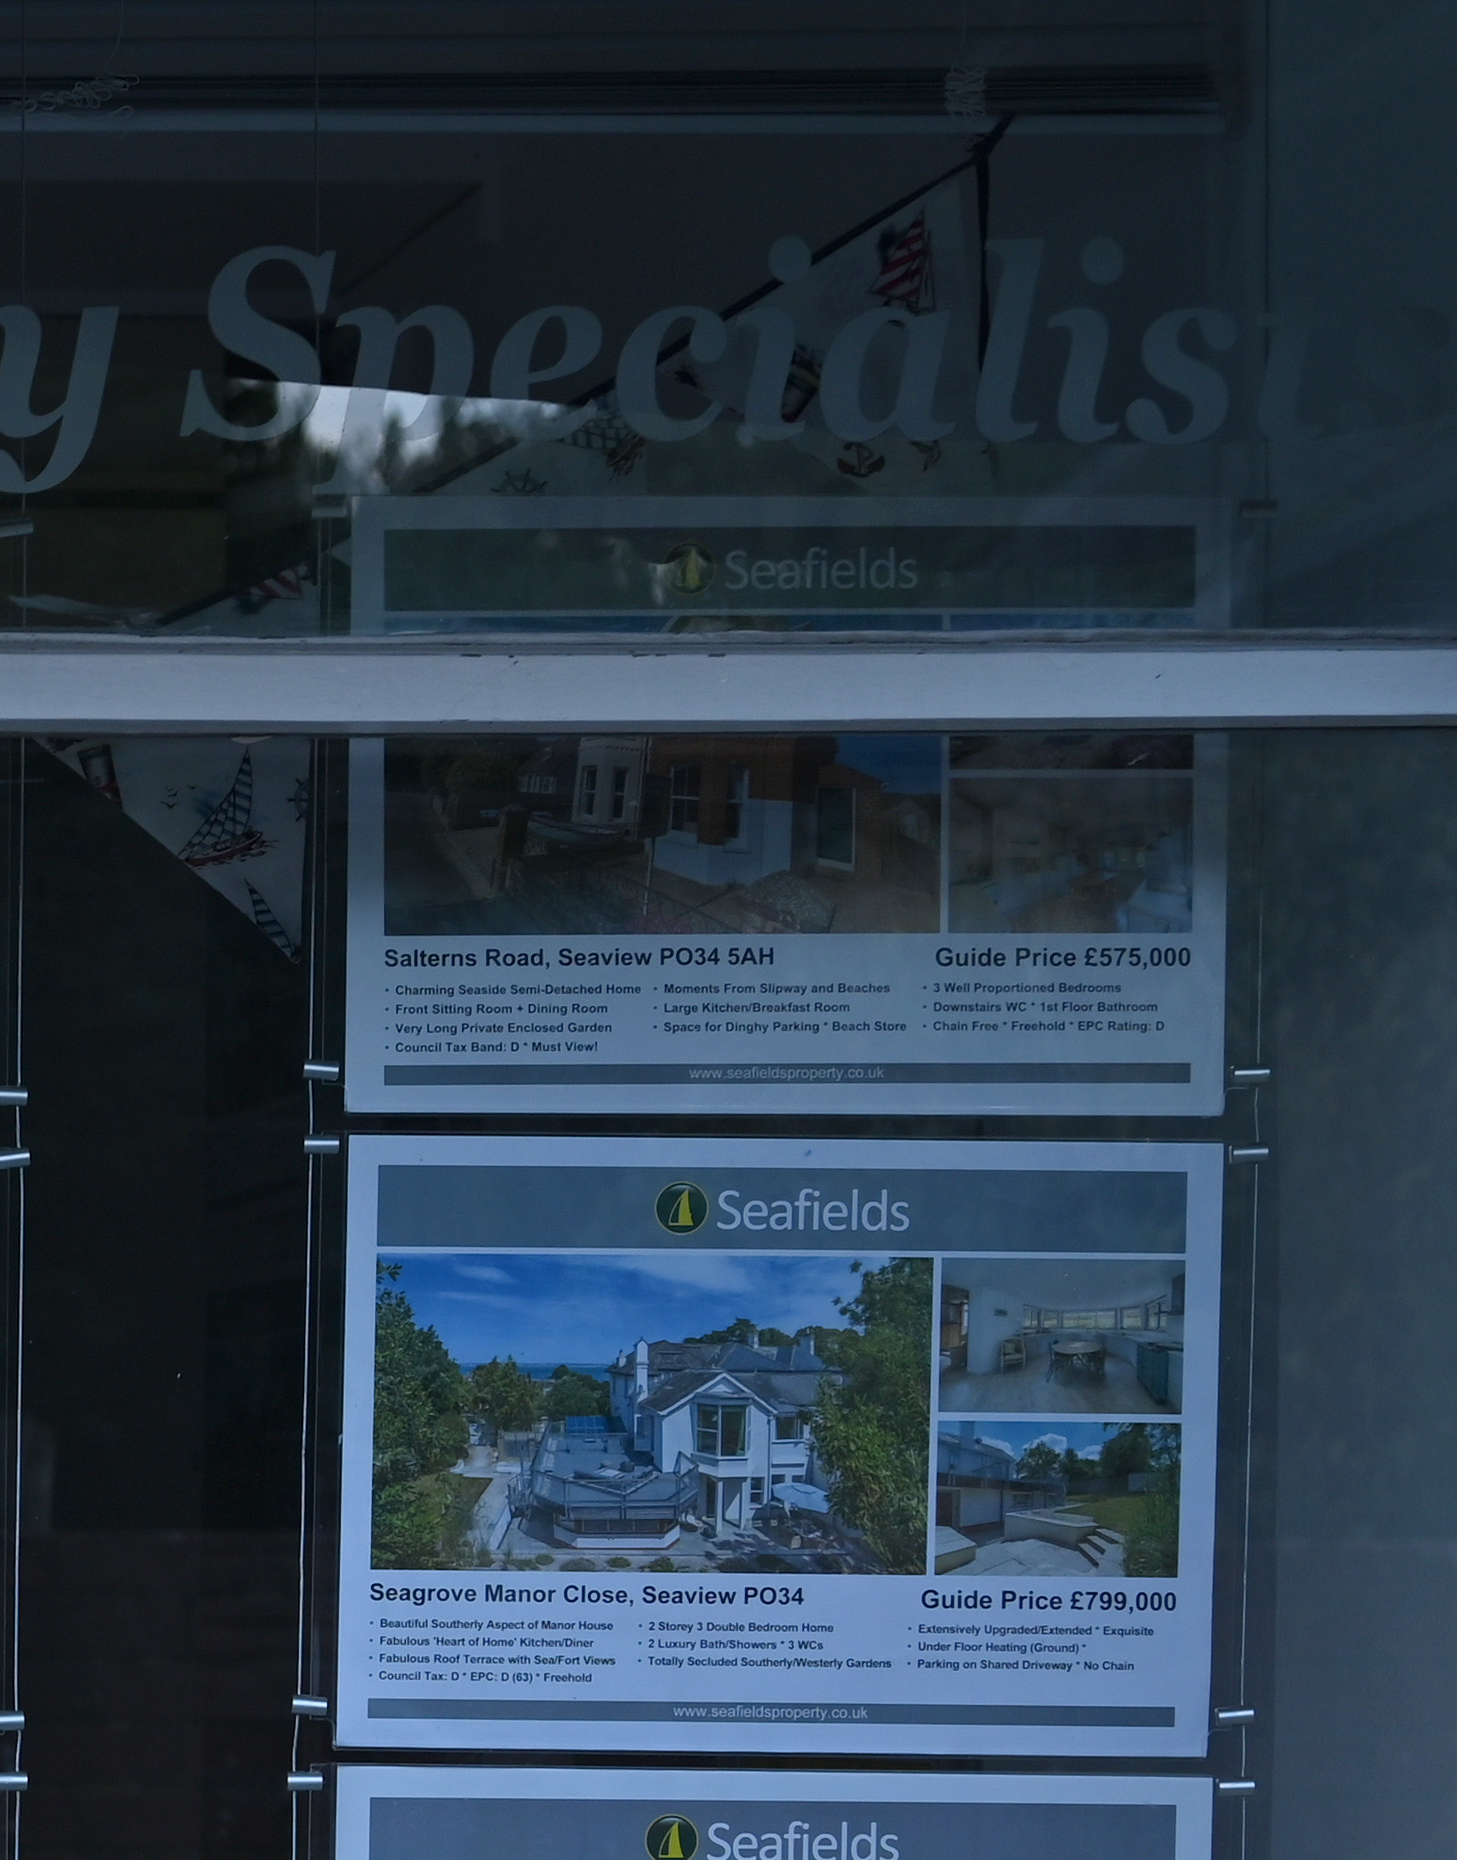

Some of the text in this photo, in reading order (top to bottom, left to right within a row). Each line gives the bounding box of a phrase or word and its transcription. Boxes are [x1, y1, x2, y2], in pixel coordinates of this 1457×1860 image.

[723, 545, 919, 592] Seafields
[384, 946, 774, 970] Salterns Road, Seaview PO34 5AH
[934, 946, 1191, 970] Guide Price £575,000
[394, 1021, 613, 1036] Very Long Private Enclosed Garden
[688, 1065, 885, 1082] www.seafieldsproperty.co.uk
[716, 1187, 910, 1231] Seafields
[369, 1582, 805, 1607] Seagrove Manor Close, Seaview PO34
[920, 1589, 1177, 1615] Guide Price £799,000
[672, 1704, 868, 1721] www.seafieldsproperty.co.uk
